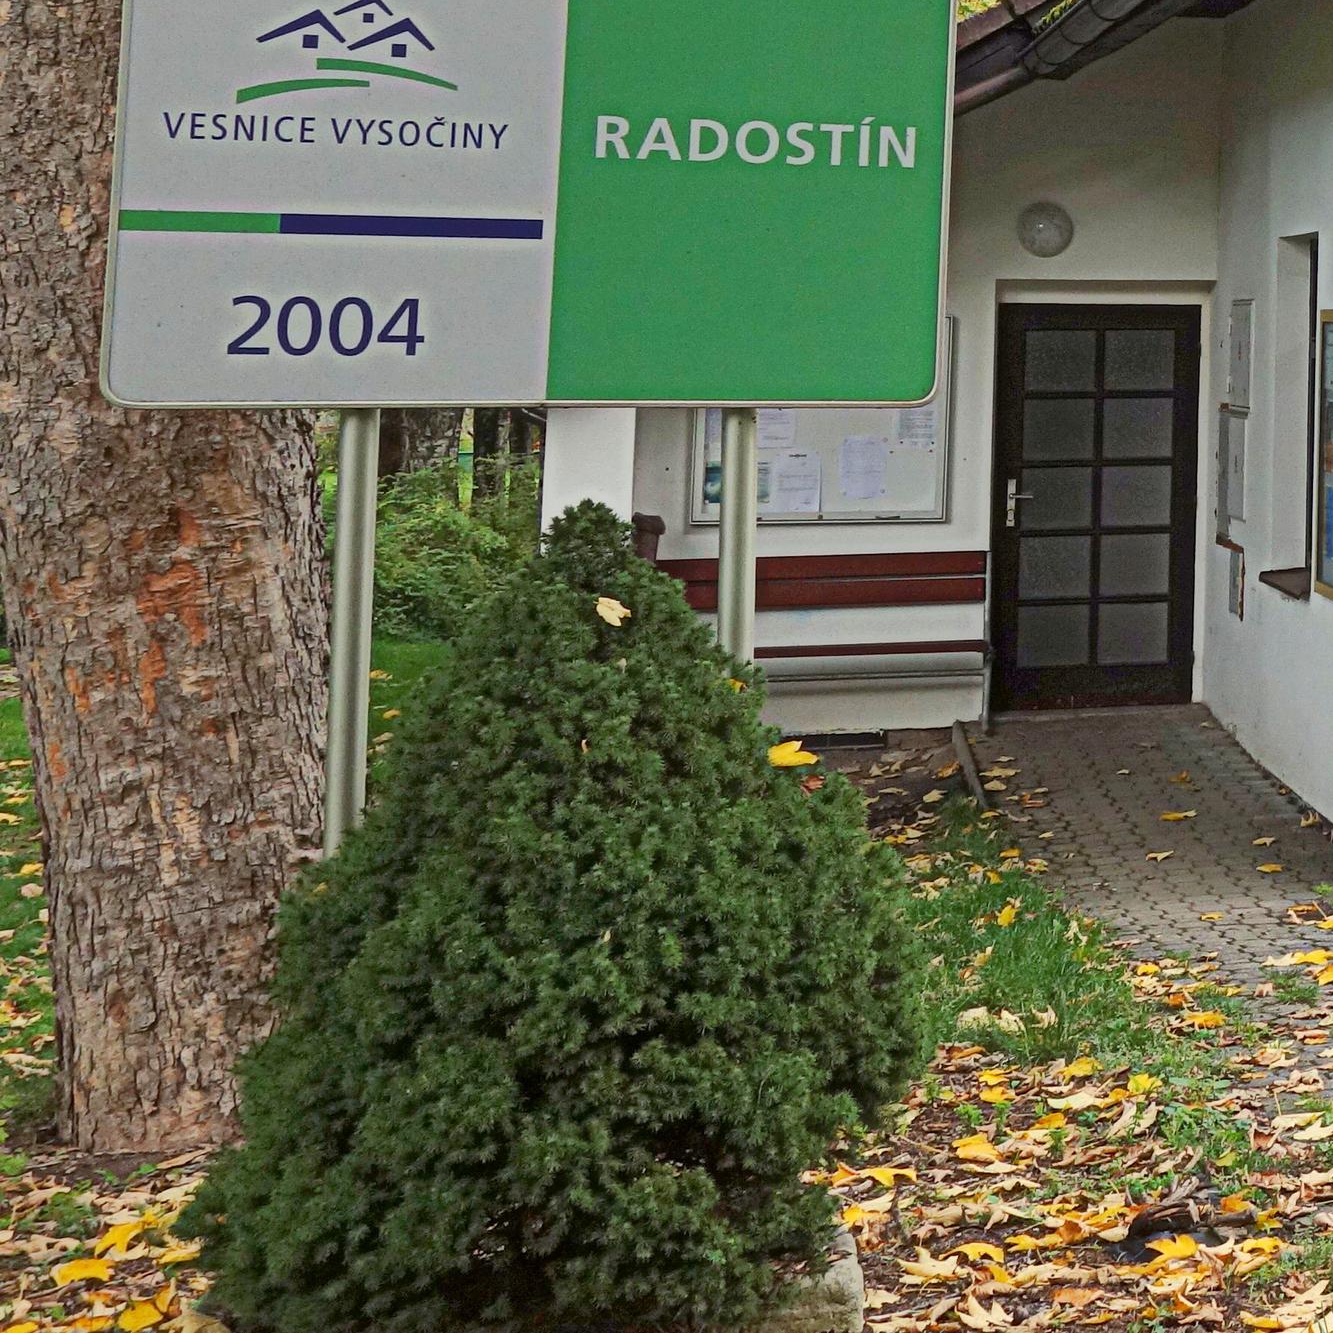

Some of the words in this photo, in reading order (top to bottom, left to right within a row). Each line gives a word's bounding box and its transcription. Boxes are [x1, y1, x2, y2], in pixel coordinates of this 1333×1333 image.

[162, 111, 316, 144] VESNICE
[330, 116, 509, 150] VYSOČINY
[595, 115, 916, 168] RADOSTÍN
[226, 295, 425, 357] 2004
